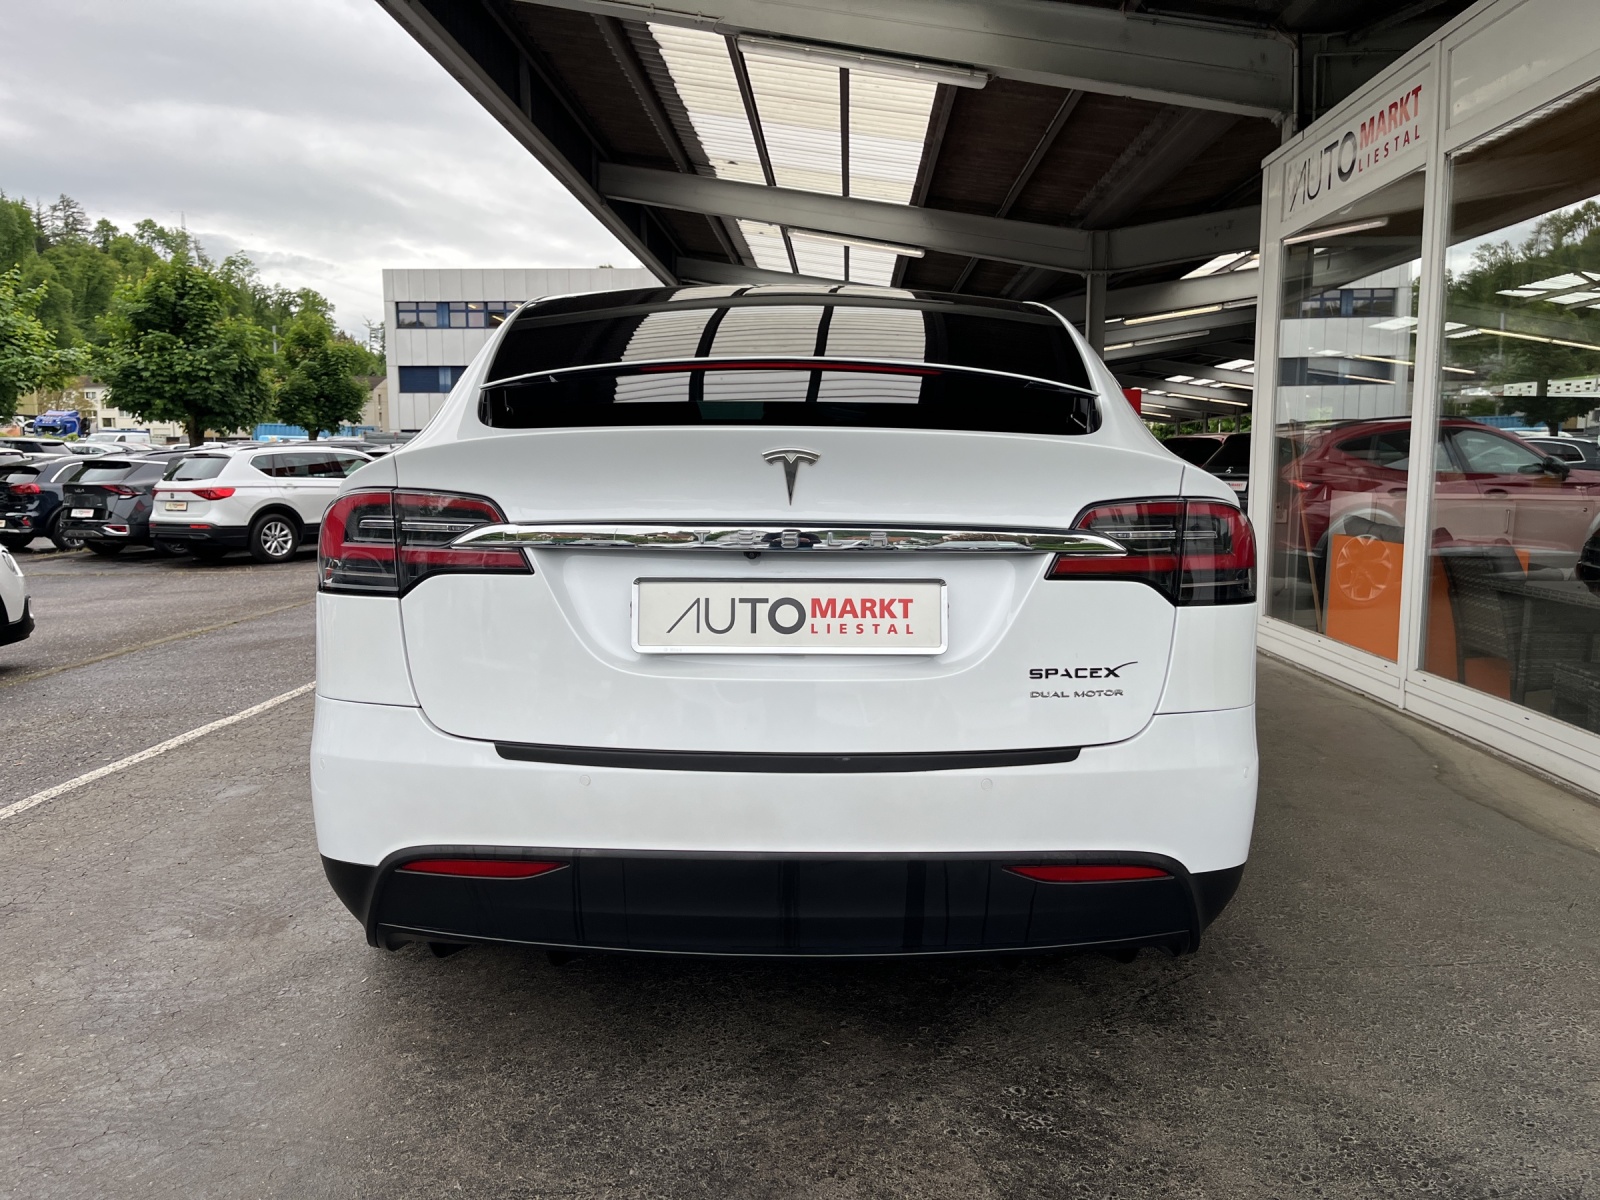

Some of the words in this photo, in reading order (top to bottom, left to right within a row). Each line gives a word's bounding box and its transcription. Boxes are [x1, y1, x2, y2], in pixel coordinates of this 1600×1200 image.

[1289, 131, 1357, 212] AUTO
[1359, 84, 1422, 150] MARKT
[1358, 124, 1420, 173] LIESTAL
[666, 597, 807, 635] AUTO
[810, 597, 914, 619] MARKT
[810, 623, 914, 635] LIESTAL
[1029, 661, 1138, 679] SPACEX
[1074, 689, 1123, 698] MOTOR
